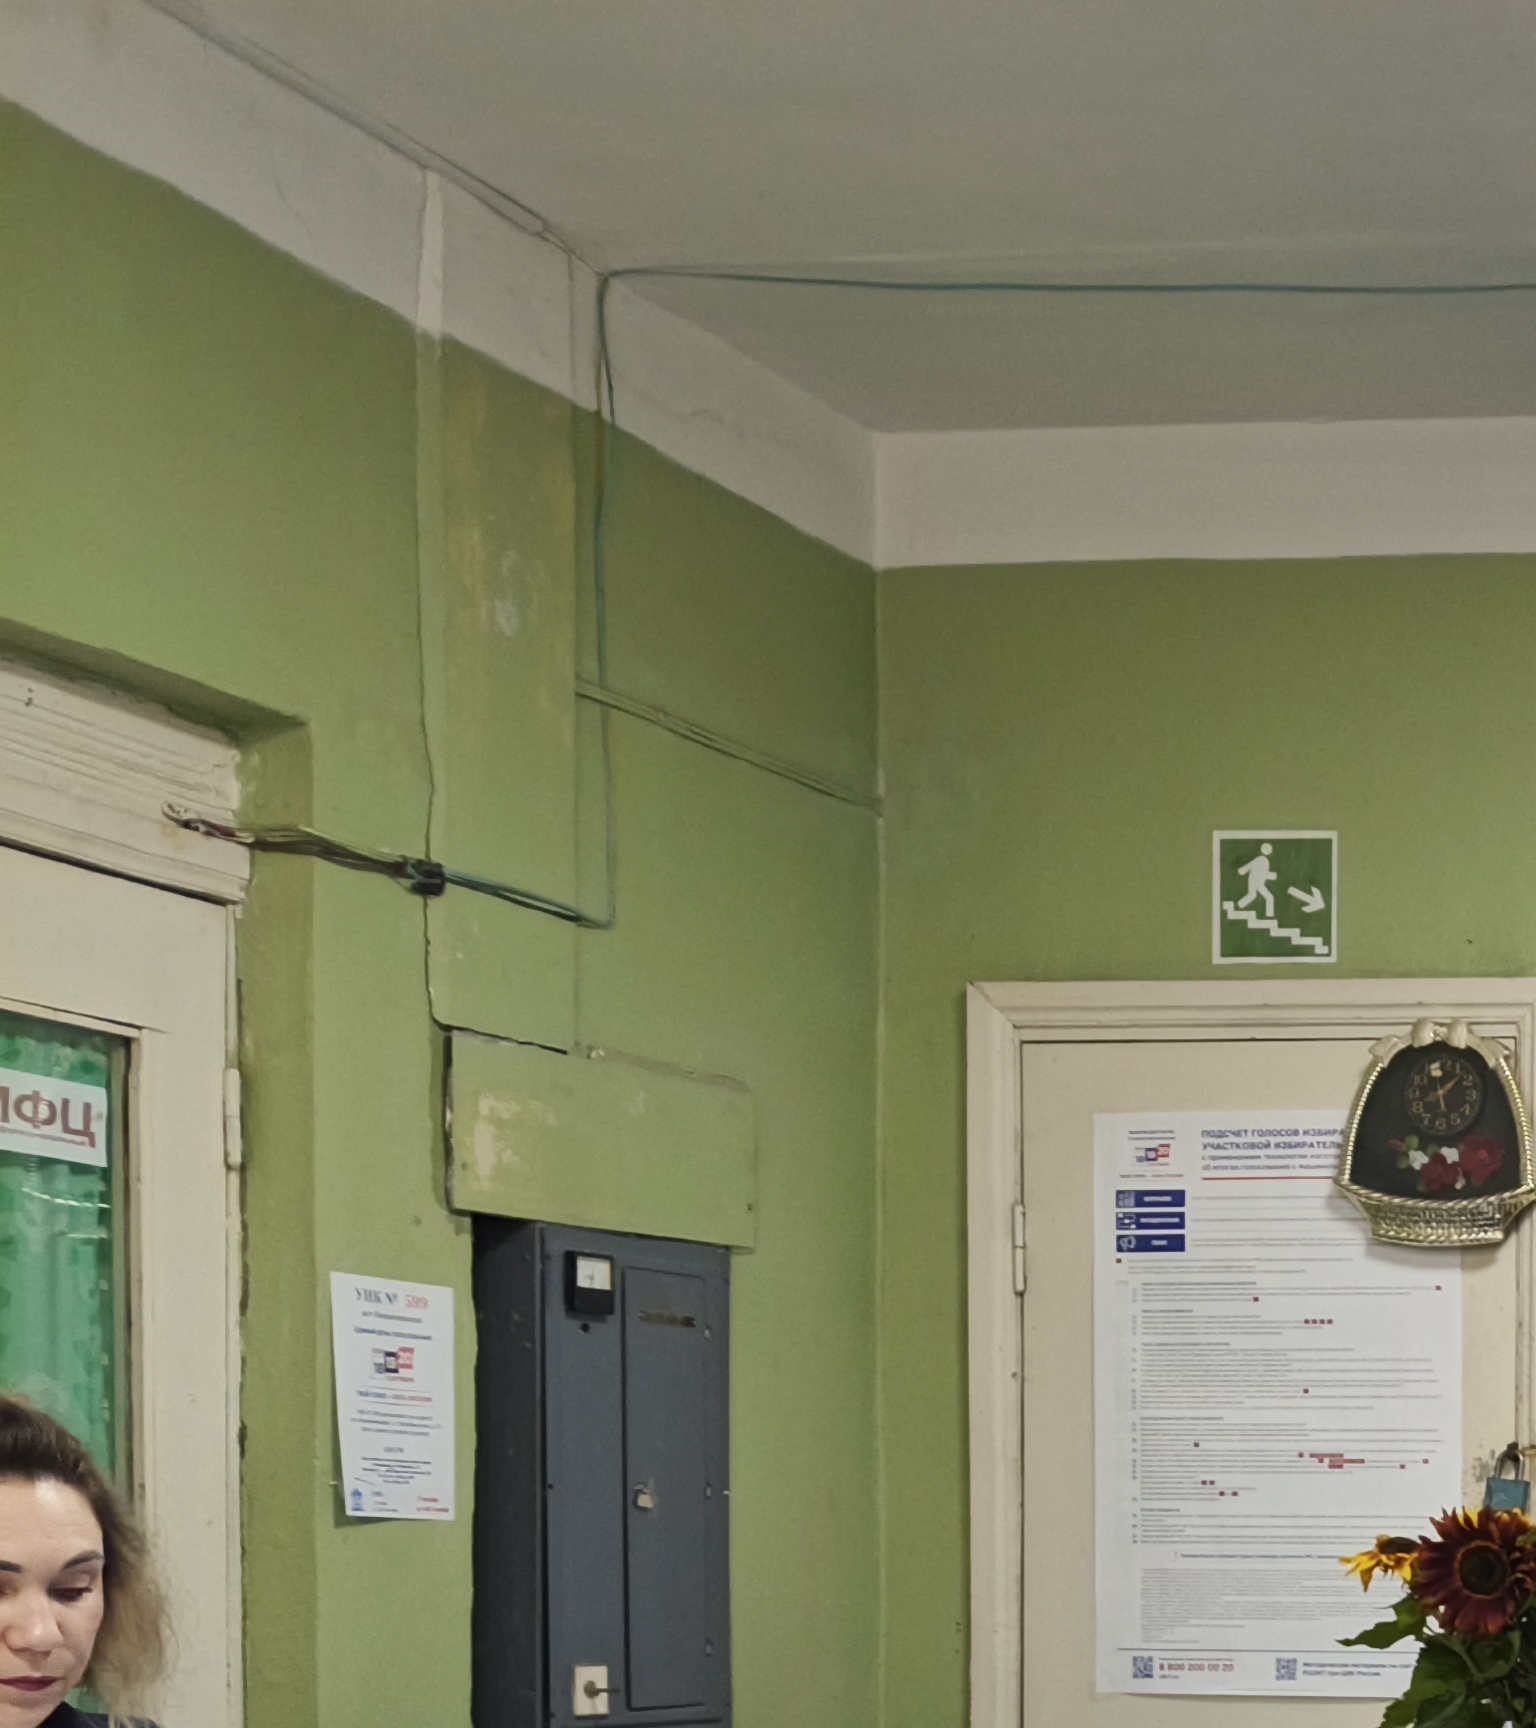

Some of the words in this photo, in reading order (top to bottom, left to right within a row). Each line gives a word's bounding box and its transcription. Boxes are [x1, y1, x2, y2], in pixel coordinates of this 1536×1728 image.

[1201, 1129, 1248, 1138] ПОДСЧЕТ
[1252, 1128, 1299, 1137] ГОЛОСОВ
[1303, 1129, 1344, 1137] ИЗБИРА
[1203, 1140, 1271, 1150] УЧАСТКОВОЙ
